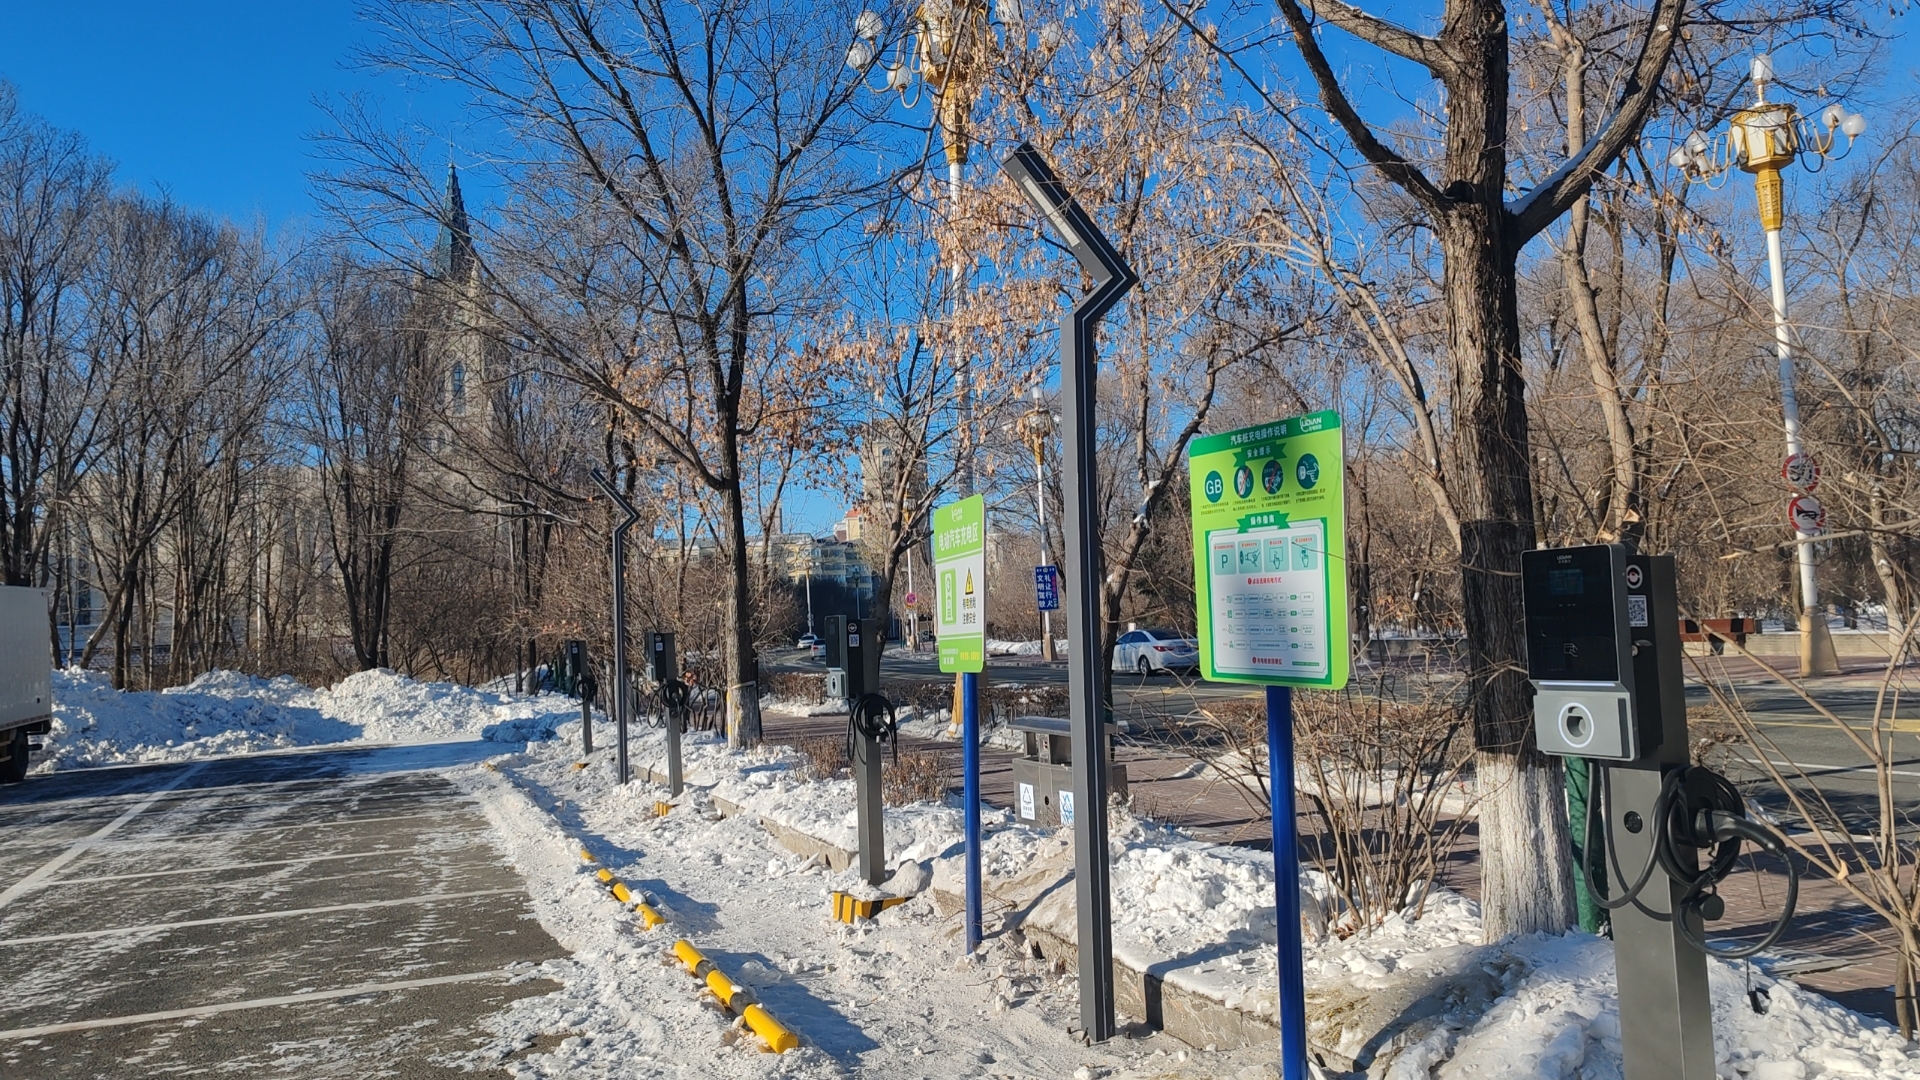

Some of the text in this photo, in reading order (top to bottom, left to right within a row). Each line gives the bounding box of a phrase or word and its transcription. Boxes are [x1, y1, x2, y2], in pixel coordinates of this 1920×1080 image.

[1230, 424, 1287, 446] 汽车桩充电操作说明
[1247, 446, 1271, 458] 安全提示
[1206, 479, 1222, 495] GB
[939, 521, 978, 551] 电动汽车充电区
[1221, 554, 1228, 569] P
[1037, 574, 1046, 608] 文明驾驶
[1044, 574, 1053, 608] 礼让行人
